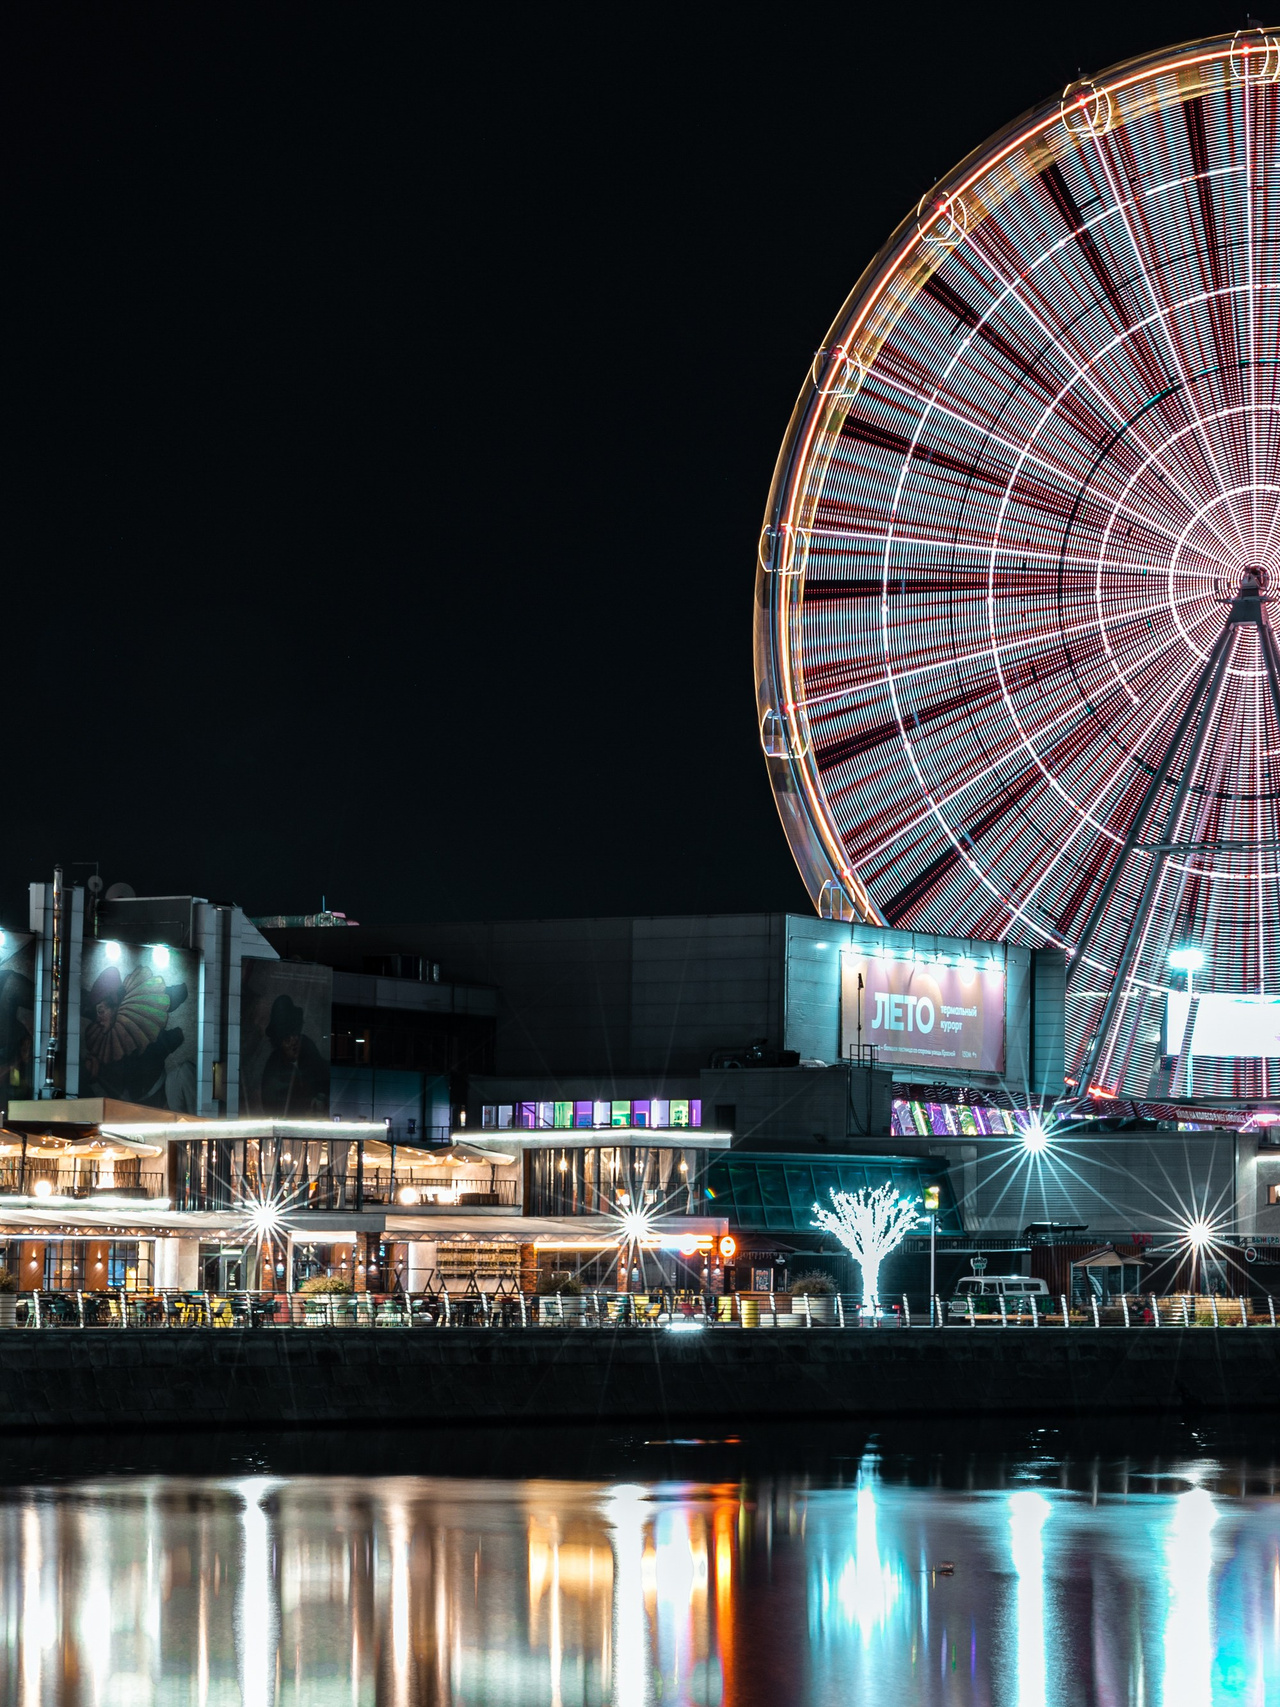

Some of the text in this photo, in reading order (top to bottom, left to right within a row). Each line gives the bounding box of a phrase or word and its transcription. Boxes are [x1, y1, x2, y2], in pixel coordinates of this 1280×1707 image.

[871, 992, 935, 1034] ЛЕТО
[940, 1005, 977, 1017] термальный
[940, 1020, 962, 1033] курорт
